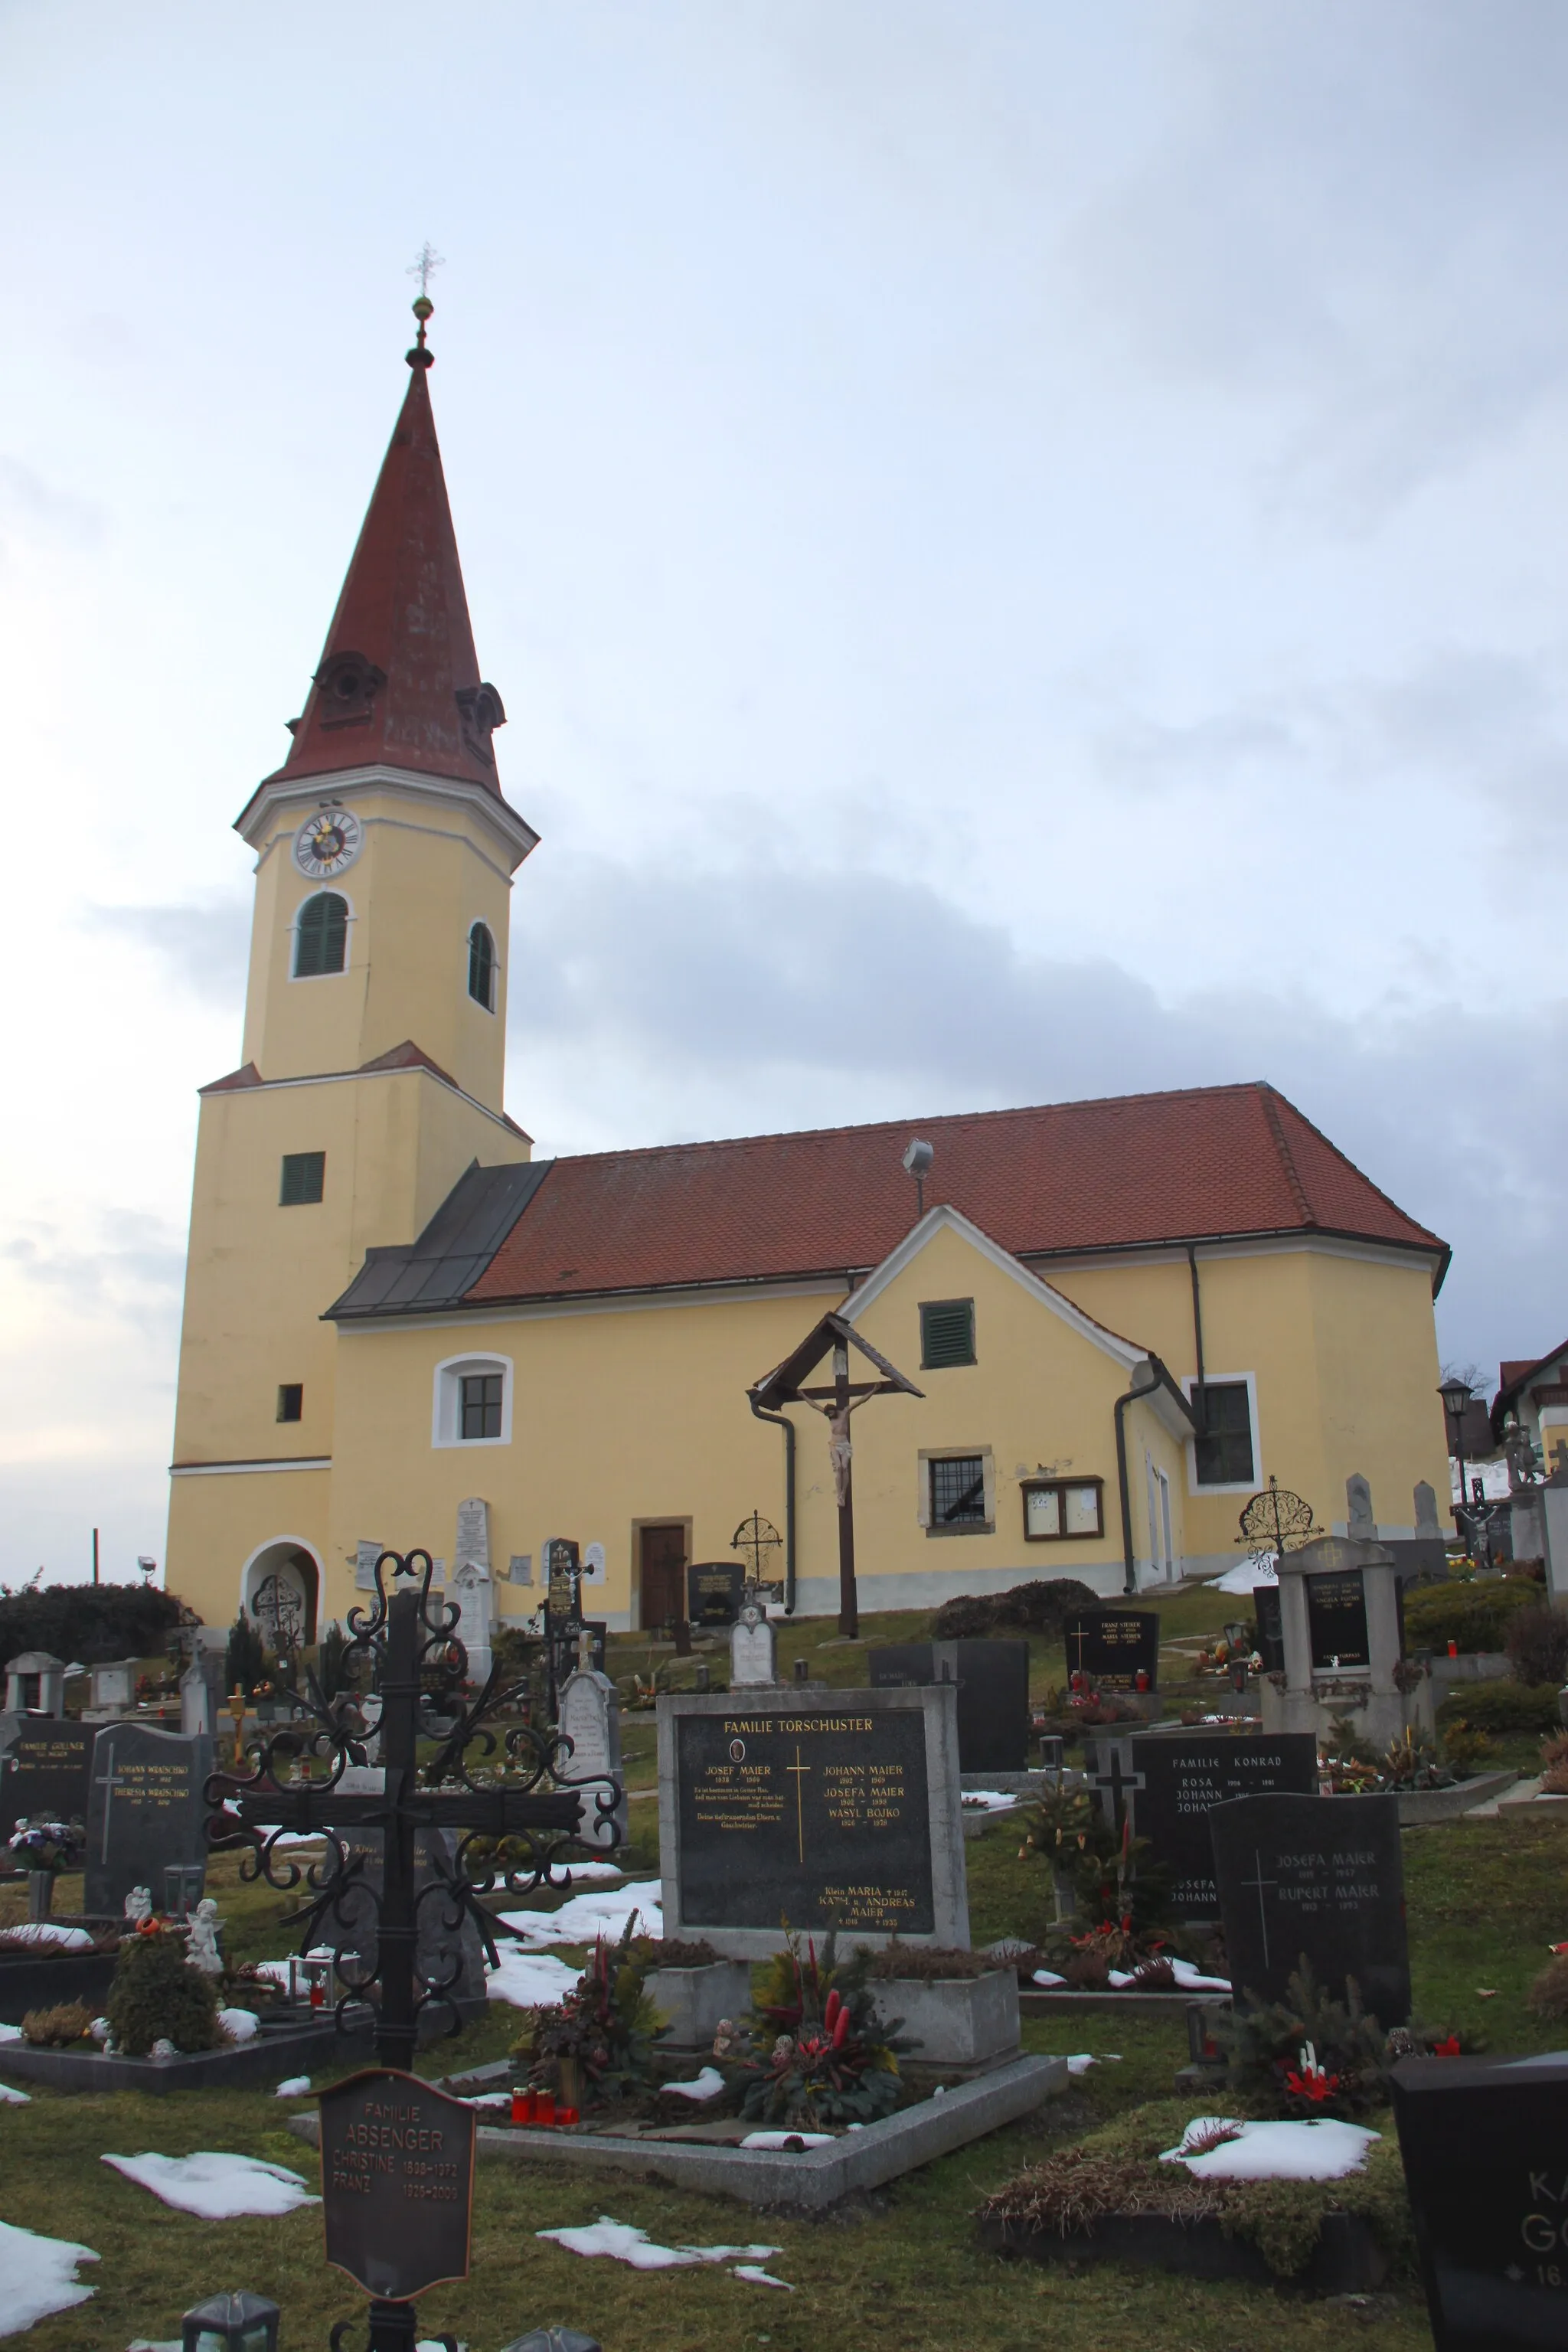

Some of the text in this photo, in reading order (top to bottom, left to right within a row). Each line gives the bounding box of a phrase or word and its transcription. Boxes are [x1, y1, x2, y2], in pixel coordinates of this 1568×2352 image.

[724, 1718, 873, 1733] FAMILIE TORSCHUSTER
[1172, 1756, 1282, 1768] FAMILIE KONRAD
[117, 1765, 145, 1774] JOHANN
[705, 1766, 771, 1775] JOSEF MAIER
[823, 1765, 903, 1776] JOHANN MAIER
[1182, 1778, 1213, 1787] ROSA
[114, 1788, 145, 1796] THERESIA
[824, 1787, 905, 1798] JOSEFA MAIER
[1176, 1790, 1223, 1800] JOHANN
[828, 1808, 900, 1818] WASYL BOJKO
[1276, 1851, 1376, 1868] JOSEFA MAIER
[1171, 1880, 1216, 1890] JOSEFA
[825, 1886, 844, 1895] Klein
[848, 1886, 881, 1896] MARIA
[1279, 1884, 1379, 1900] RUPERT MAIER
[866, 1898, 915, 1907] ANDREAS
[1171, 1892, 1217, 1903] JOHANN
[851, 1907, 884, 1917] MAIER
[364, 2102, 420, 2122] FAMILIE
[345, 2123, 443, 2151] ABSENGER
[333, 2149, 394, 2173] CHRISTINE
[333, 2171, 371, 2193] FRANZ
[1521, 2213, 1568, 2252] G
